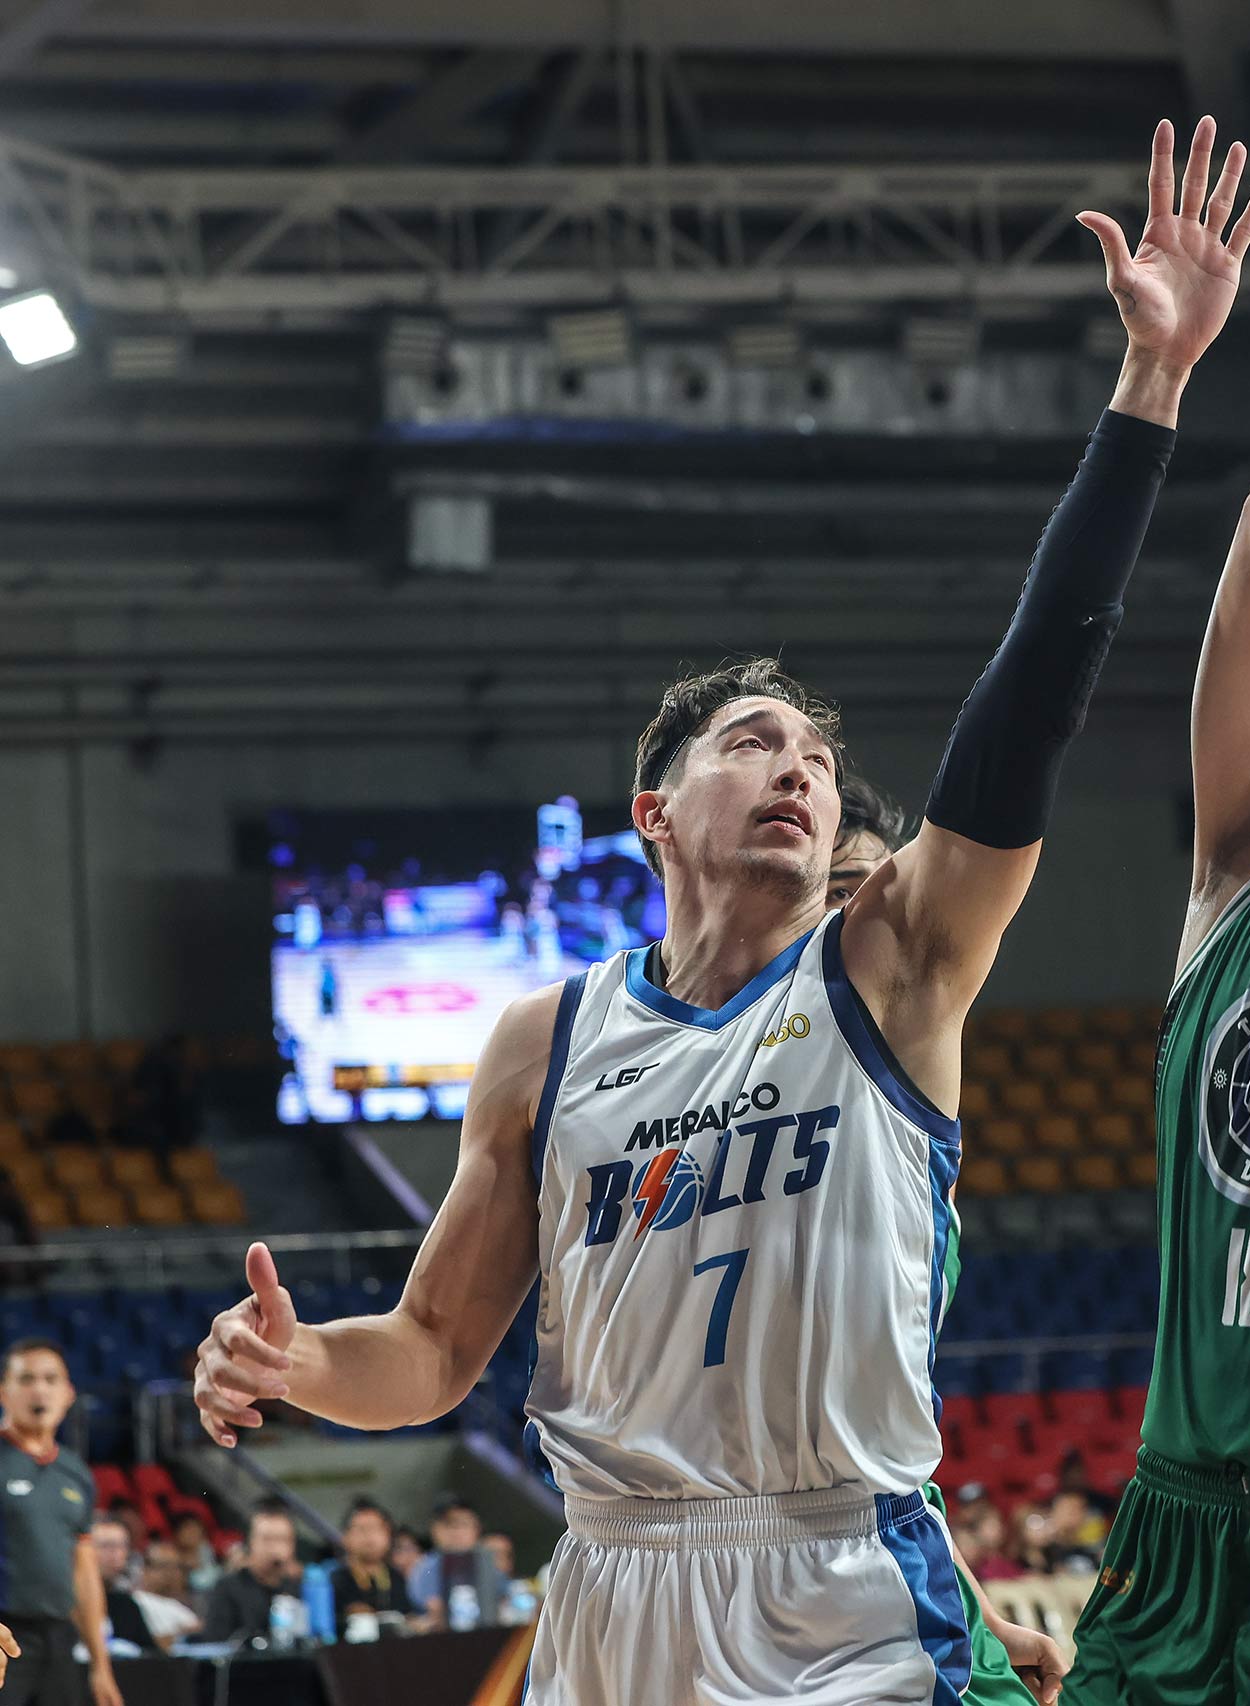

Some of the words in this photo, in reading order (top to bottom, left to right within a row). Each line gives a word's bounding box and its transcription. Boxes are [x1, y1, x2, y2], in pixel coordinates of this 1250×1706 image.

[584, 1104, 841, 1248] BOLTS
[623, 1082, 781, 1153] MERALCO
[692, 1247, 750, 1369] 7
